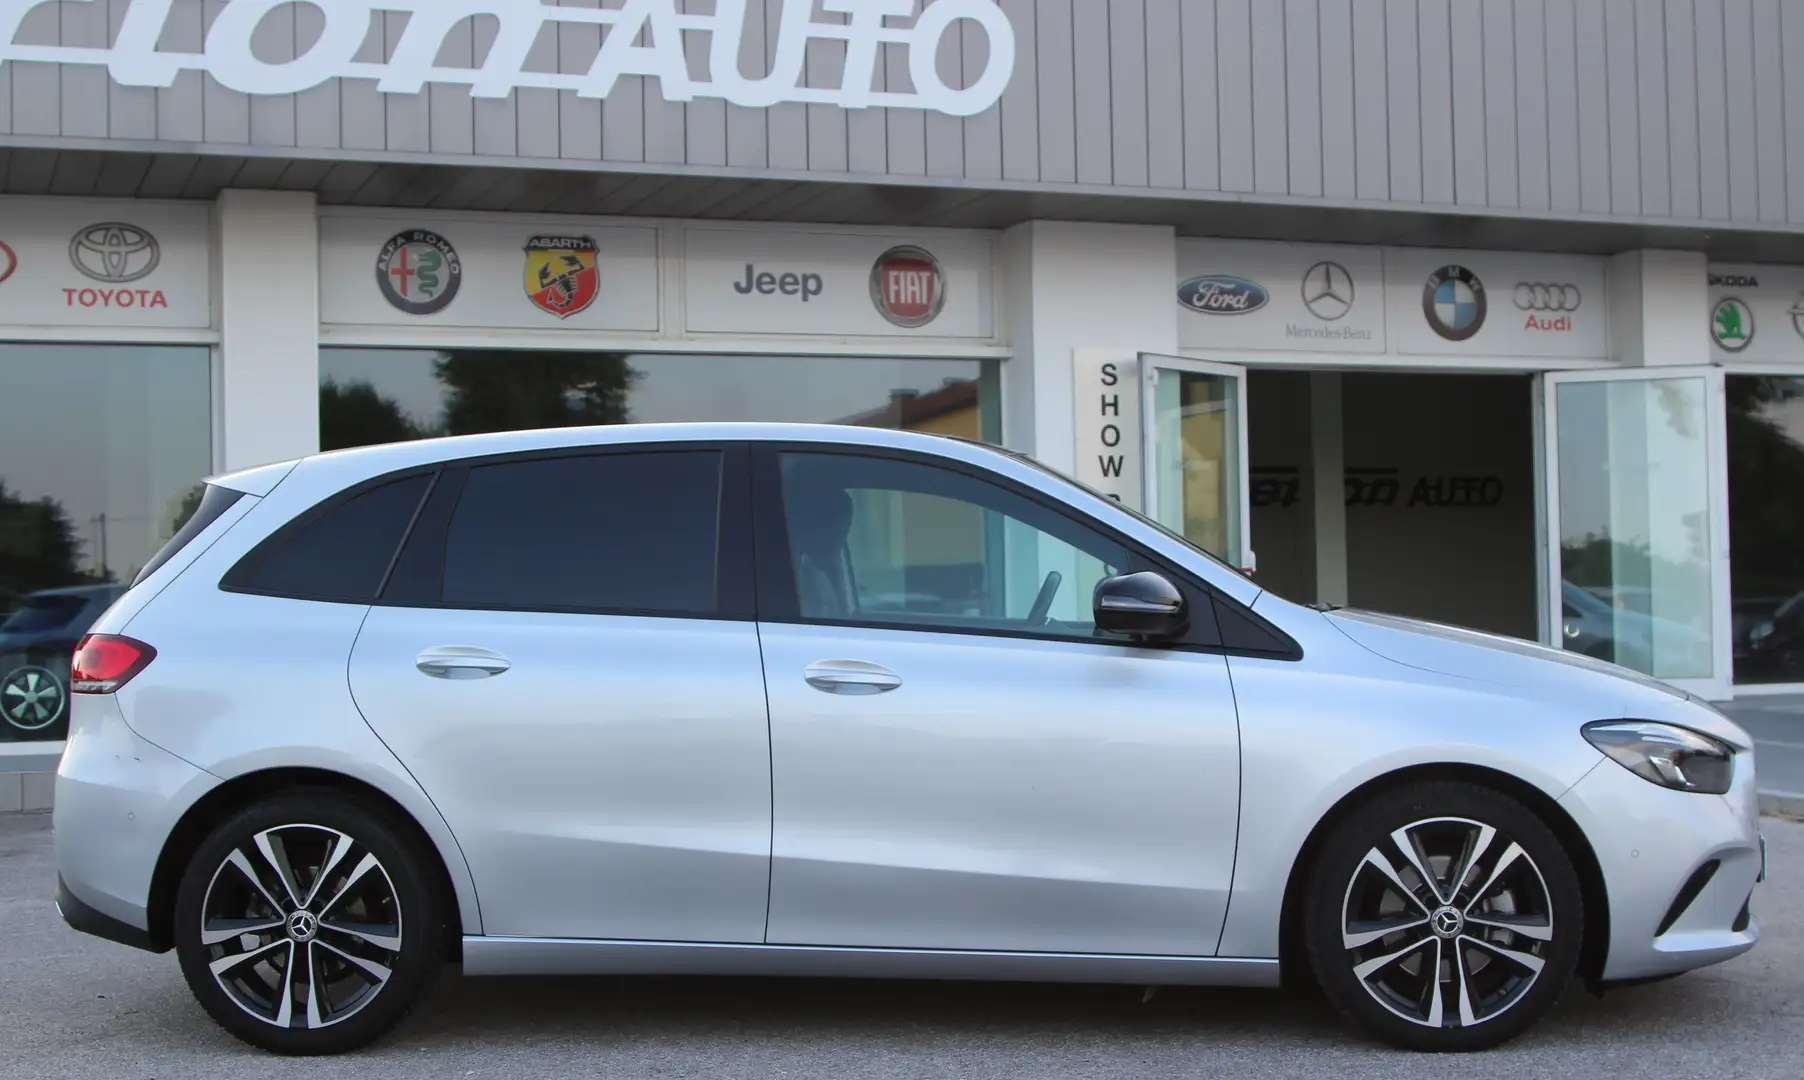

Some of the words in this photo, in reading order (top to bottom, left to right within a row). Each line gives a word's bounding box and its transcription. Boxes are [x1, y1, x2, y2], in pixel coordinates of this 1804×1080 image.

[577, 0, 1015, 116] AUTO
[377, 236, 407, 272] ALFA
[413, 231, 461, 275] ROMEO
[529, 237, 592, 250] ABARTH
[733, 263, 823, 302] Jeep
[888, 270, 931, 305] FIAT
[1428, 266, 1482, 290] BMW
[62, 287, 168, 309] TOYOTA
[1193, 280, 1249, 309] Ford
[1285, 323, 1372, 340] Mercedes-Benz
[1524, 313, 1572, 332] Audi
[1098, 362, 1124, 478] SHOW
